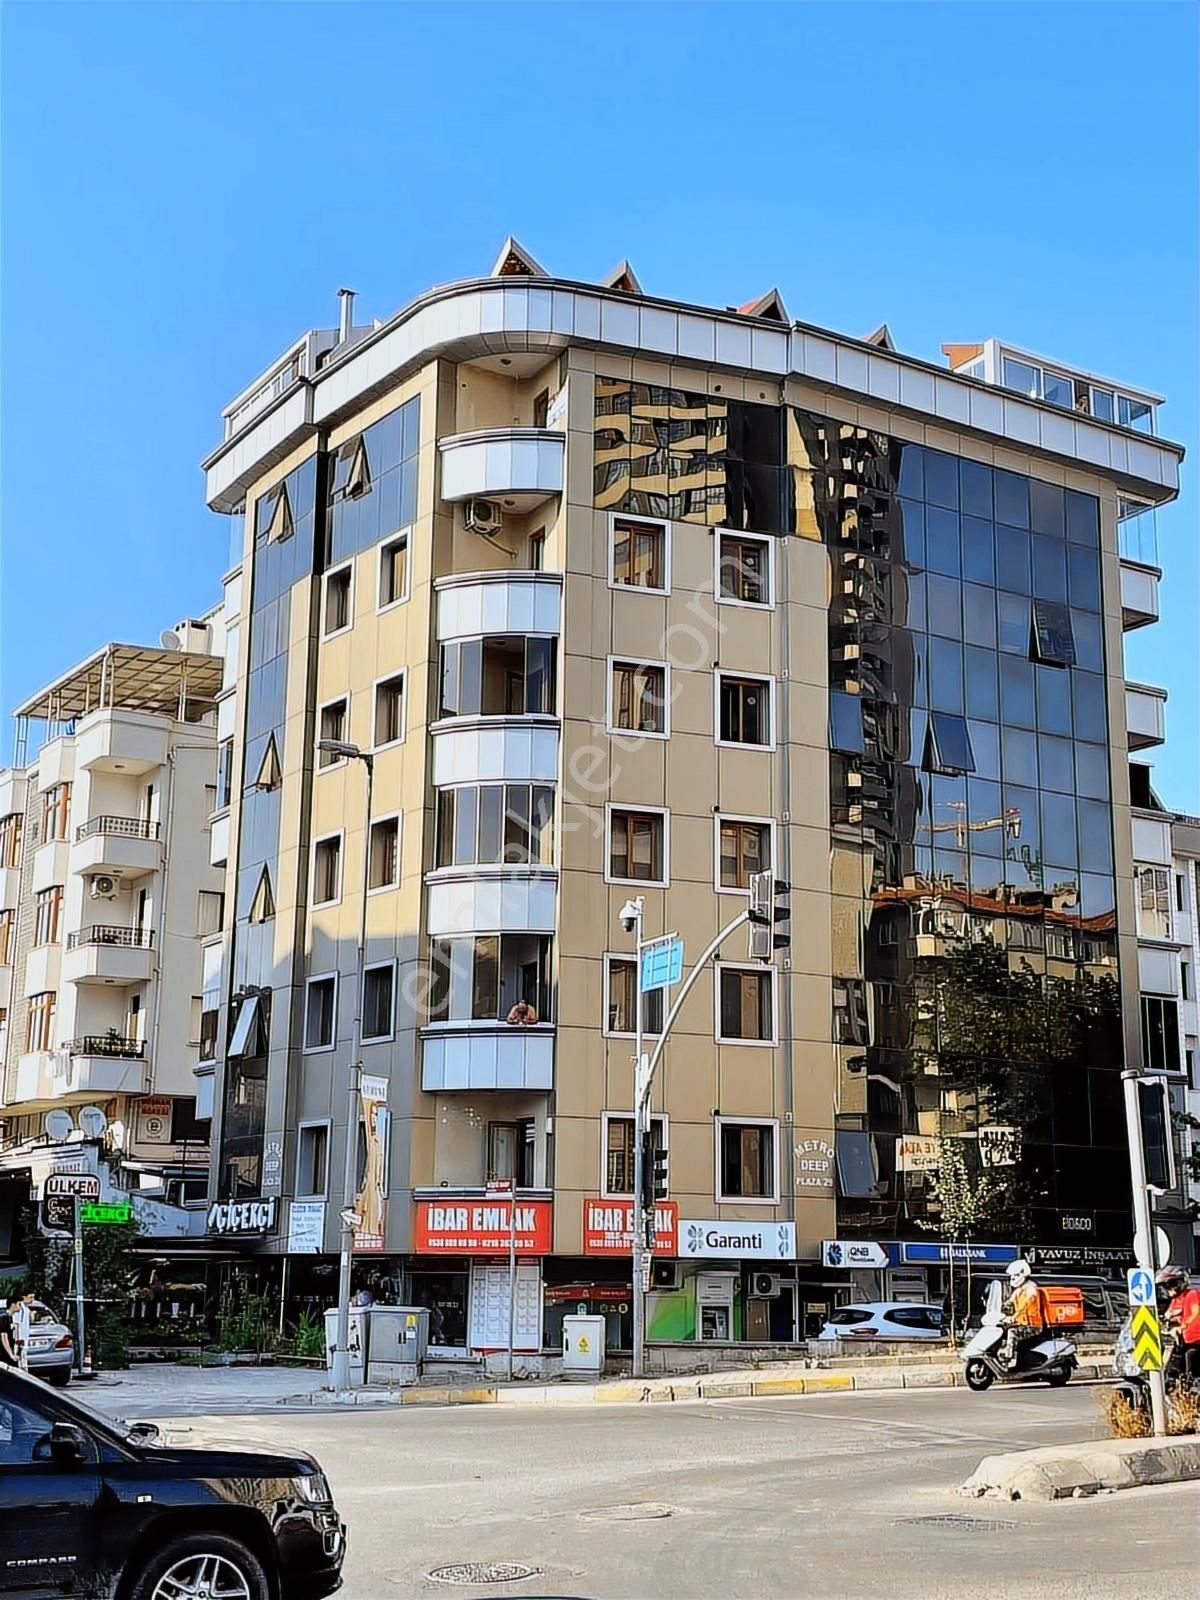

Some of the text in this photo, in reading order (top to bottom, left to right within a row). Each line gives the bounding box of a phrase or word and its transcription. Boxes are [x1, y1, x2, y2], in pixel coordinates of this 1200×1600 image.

[794, 1139, 835, 1158] METRO
[801, 1160, 828, 1172] DEEP
[796, 1176, 822, 1187] PLAZA
[427, 1203, 536, 1232] İBAR EMLAK
[588, 1201, 672, 1232] İBAR EAK
[706, 1230, 762, 1250] Garanti
[1037, 1249, 1081, 1259] YAVUZ
[1084, 1246, 1133, 1261] İNŞAAT
